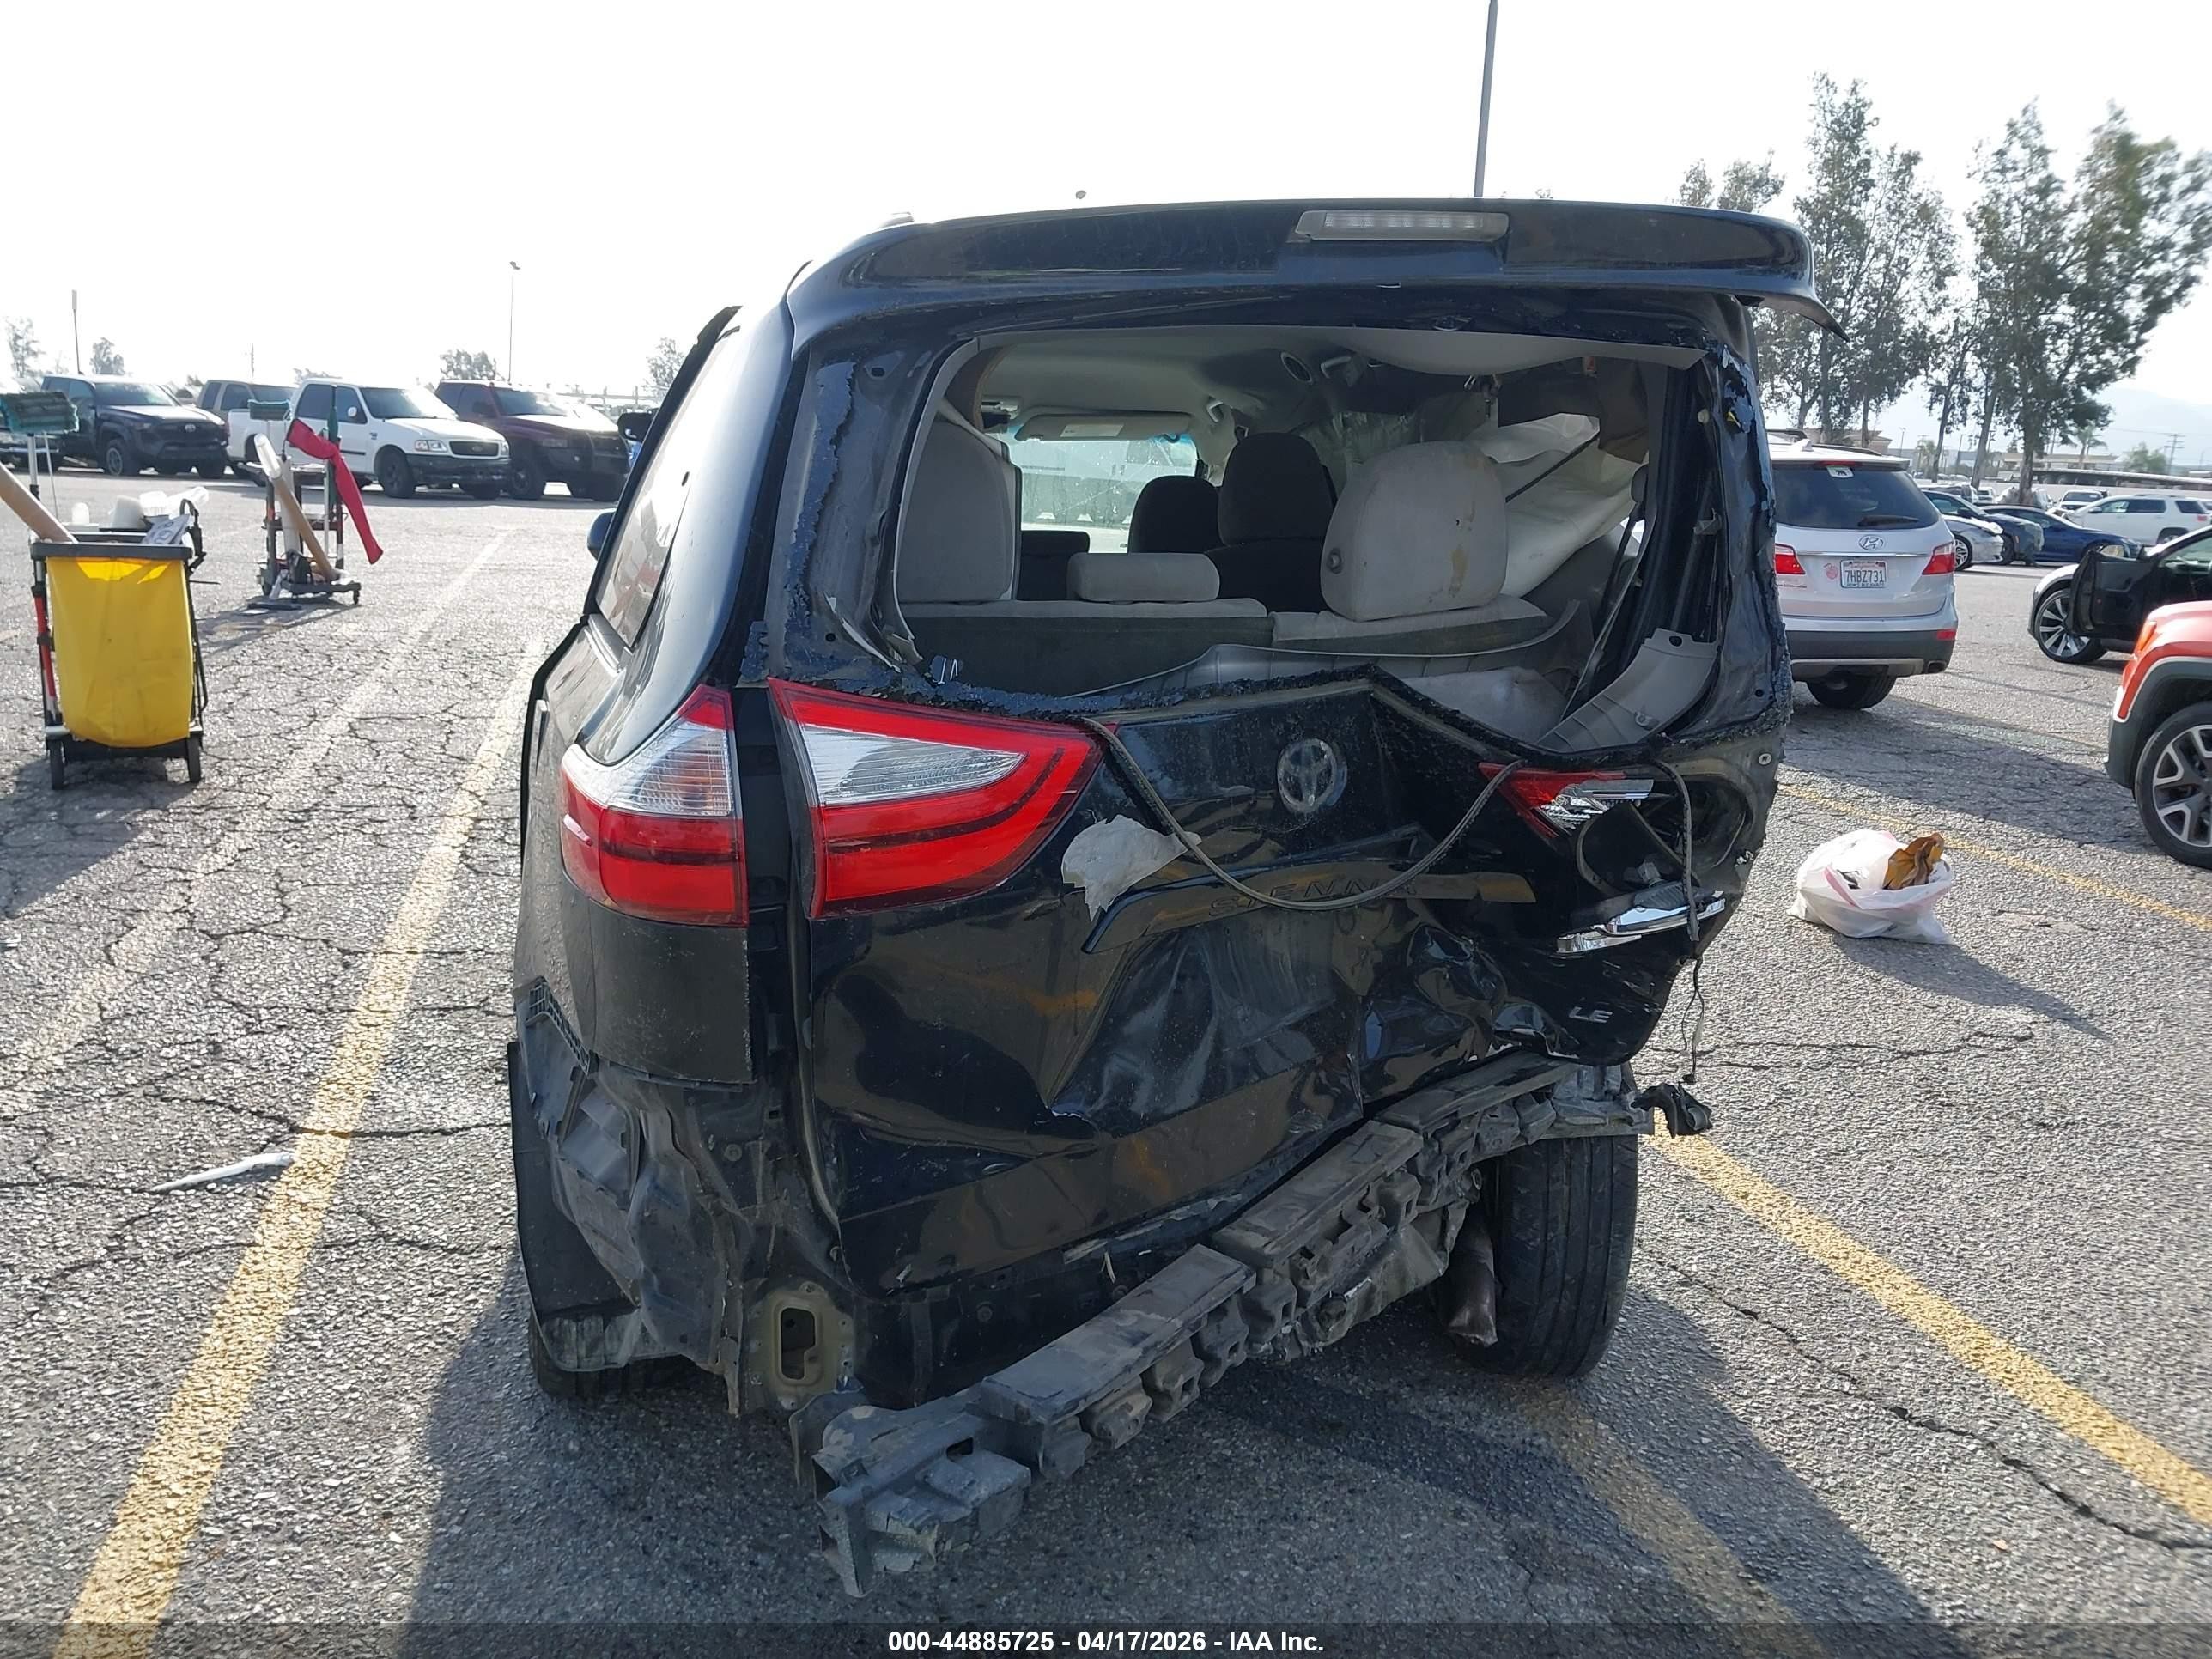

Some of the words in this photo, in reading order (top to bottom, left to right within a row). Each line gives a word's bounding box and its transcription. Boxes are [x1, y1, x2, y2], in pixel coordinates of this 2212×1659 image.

[1844, 570, 1884, 583] 7HBZ731
[1208, 878, 1418, 917] SENN
[1569, 1006, 1613, 1023] LE
